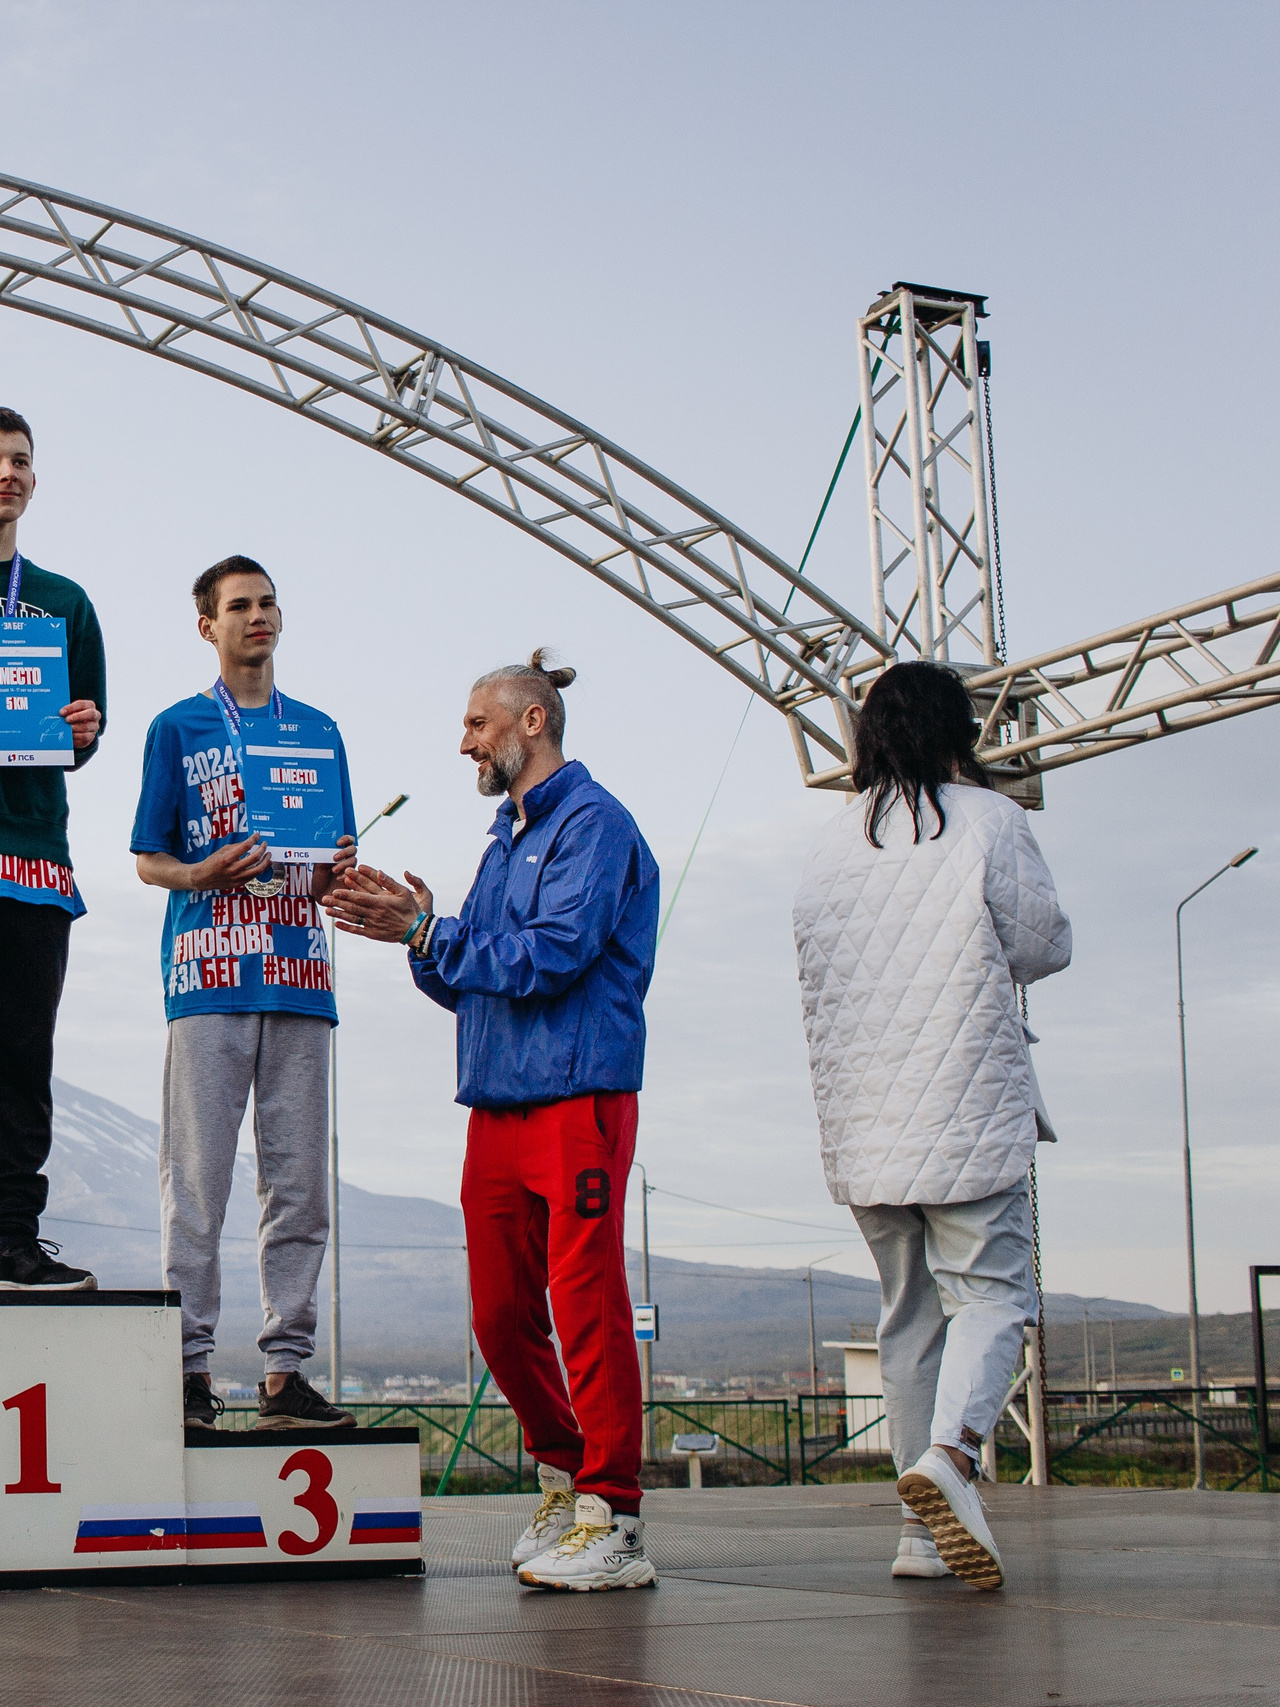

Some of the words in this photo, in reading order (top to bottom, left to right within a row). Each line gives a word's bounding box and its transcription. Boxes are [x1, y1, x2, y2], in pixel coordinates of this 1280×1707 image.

[0, 667, 42, 685] МЕСТО
[6, 696, 13, 710] 5
[14, 696, 29, 710] КМ
[219, 686, 236, 711] ОБЛАСТЬ
[182, 745, 237, 787] 2024
[281, 768, 318, 785] МЕСТО
[282, 795, 288, 809] 5
[289, 795, 303, 809] КМ
[293, 851, 310, 859] ПСБ
[212, 895, 323, 929] #ГОРДОСТ
[173, 924, 275, 965] #ЛЮБОВЬ
[170, 957, 241, 997] #ЗАБЕГ
[575, 1168, 611, 1219] 8
[3, 1383, 62, 1494] 1
[278, 1449, 338, 1556] 3
